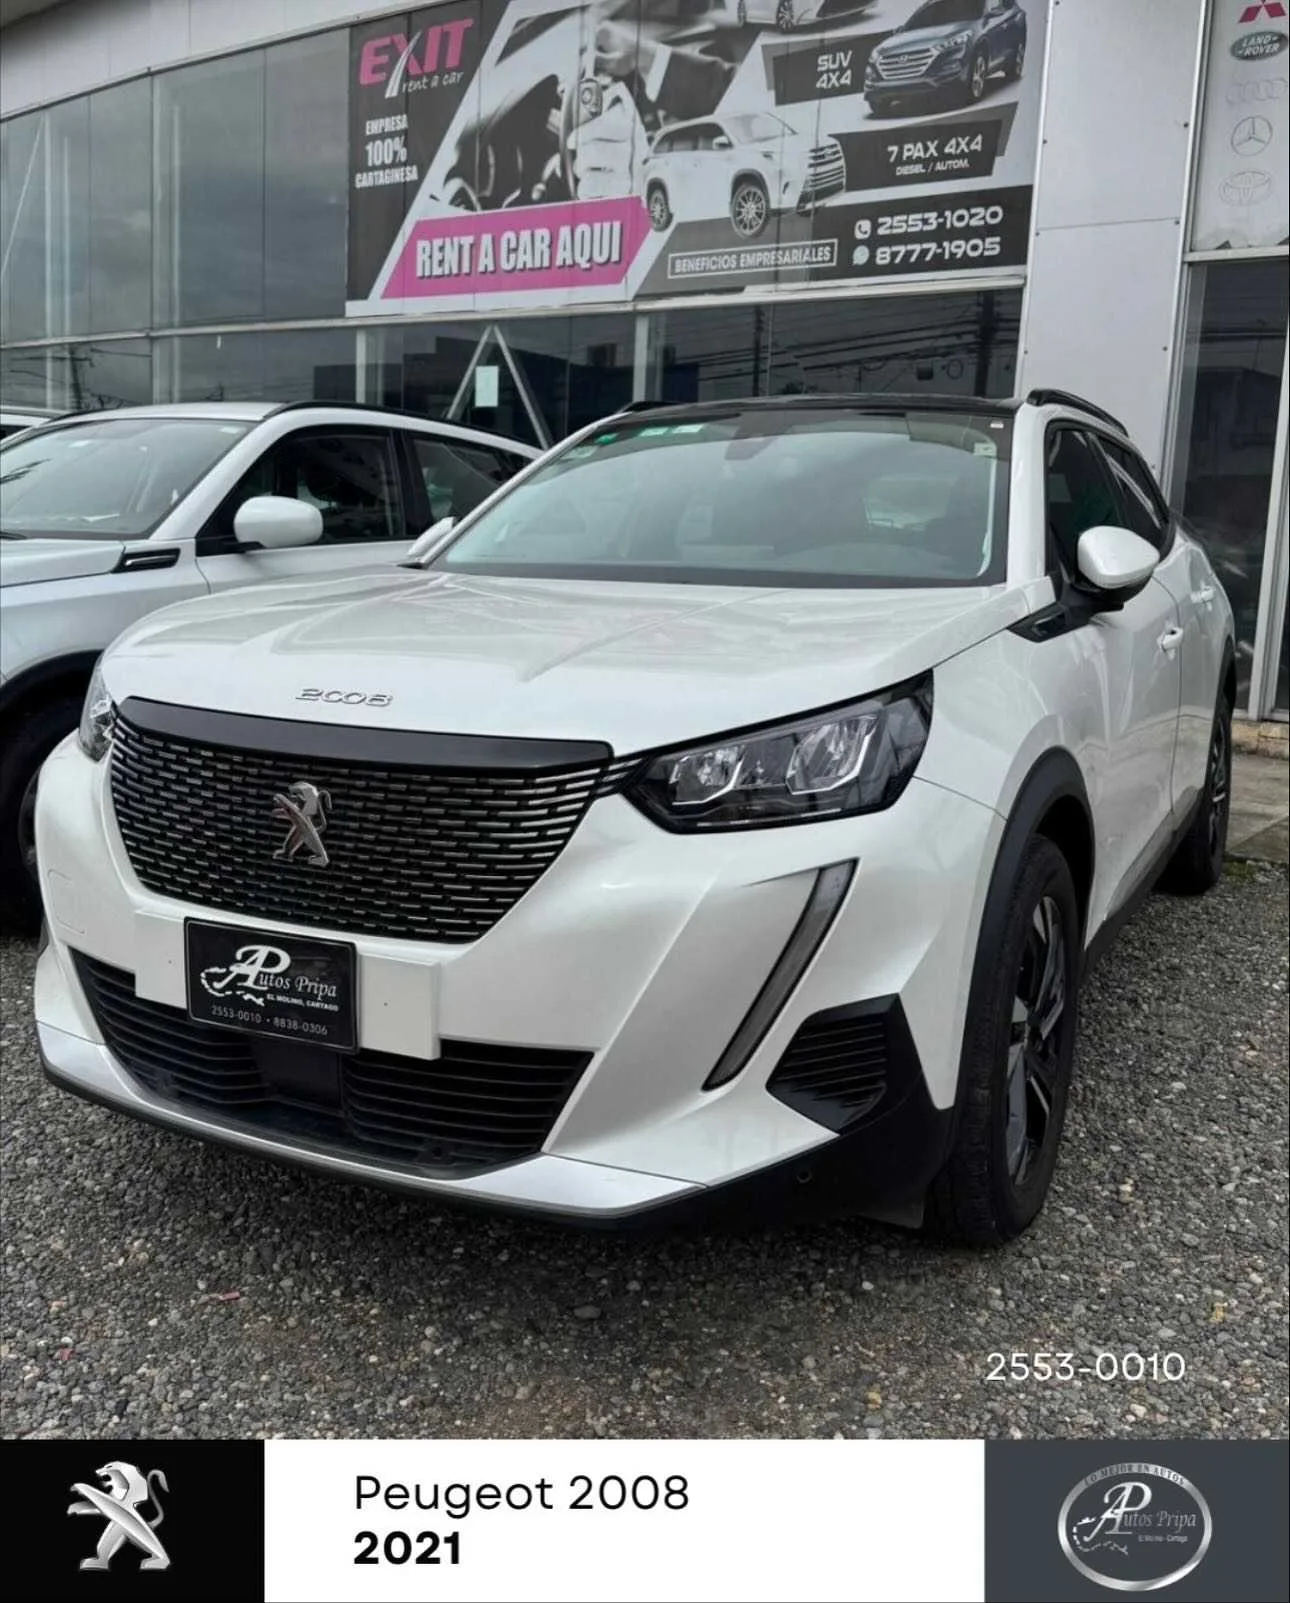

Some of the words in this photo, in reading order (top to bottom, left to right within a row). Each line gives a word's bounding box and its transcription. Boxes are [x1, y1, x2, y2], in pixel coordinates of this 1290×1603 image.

[359, 18, 474, 98] EXIT
[816, 50, 854, 72] SUV
[402, 76, 431, 94] rent
[430, 77, 440, 89] a
[442, 70, 465, 88] car
[816, 69, 853, 91] 4X4
[365, 114, 409, 136] EMPRESA
[365, 136, 408, 168] 100%
[887, 145, 899, 163] 7
[902, 140, 938, 161] PAX
[944, 133, 983, 155] 4X4
[355, 165, 419, 189] CARTAGINESA
[895, 163, 927, 176] DIESEL
[877, 205, 1004, 236] 2553-1020
[415, 235, 476, 280] RENT
[477, 232, 496, 275] A
[500, 226, 552, 273] CAR
[555, 220, 622, 273] AQUI
[674, 254, 738, 274] BENEFICIOS
[739, 245, 832, 269] EMPRESARIALES
[875, 236, 1002, 266] 8777-1905
[294, 687, 394, 708] 2008
[294, 974, 338, 1001] Pripa
[211, 1005, 262, 1024] 2553-0010
